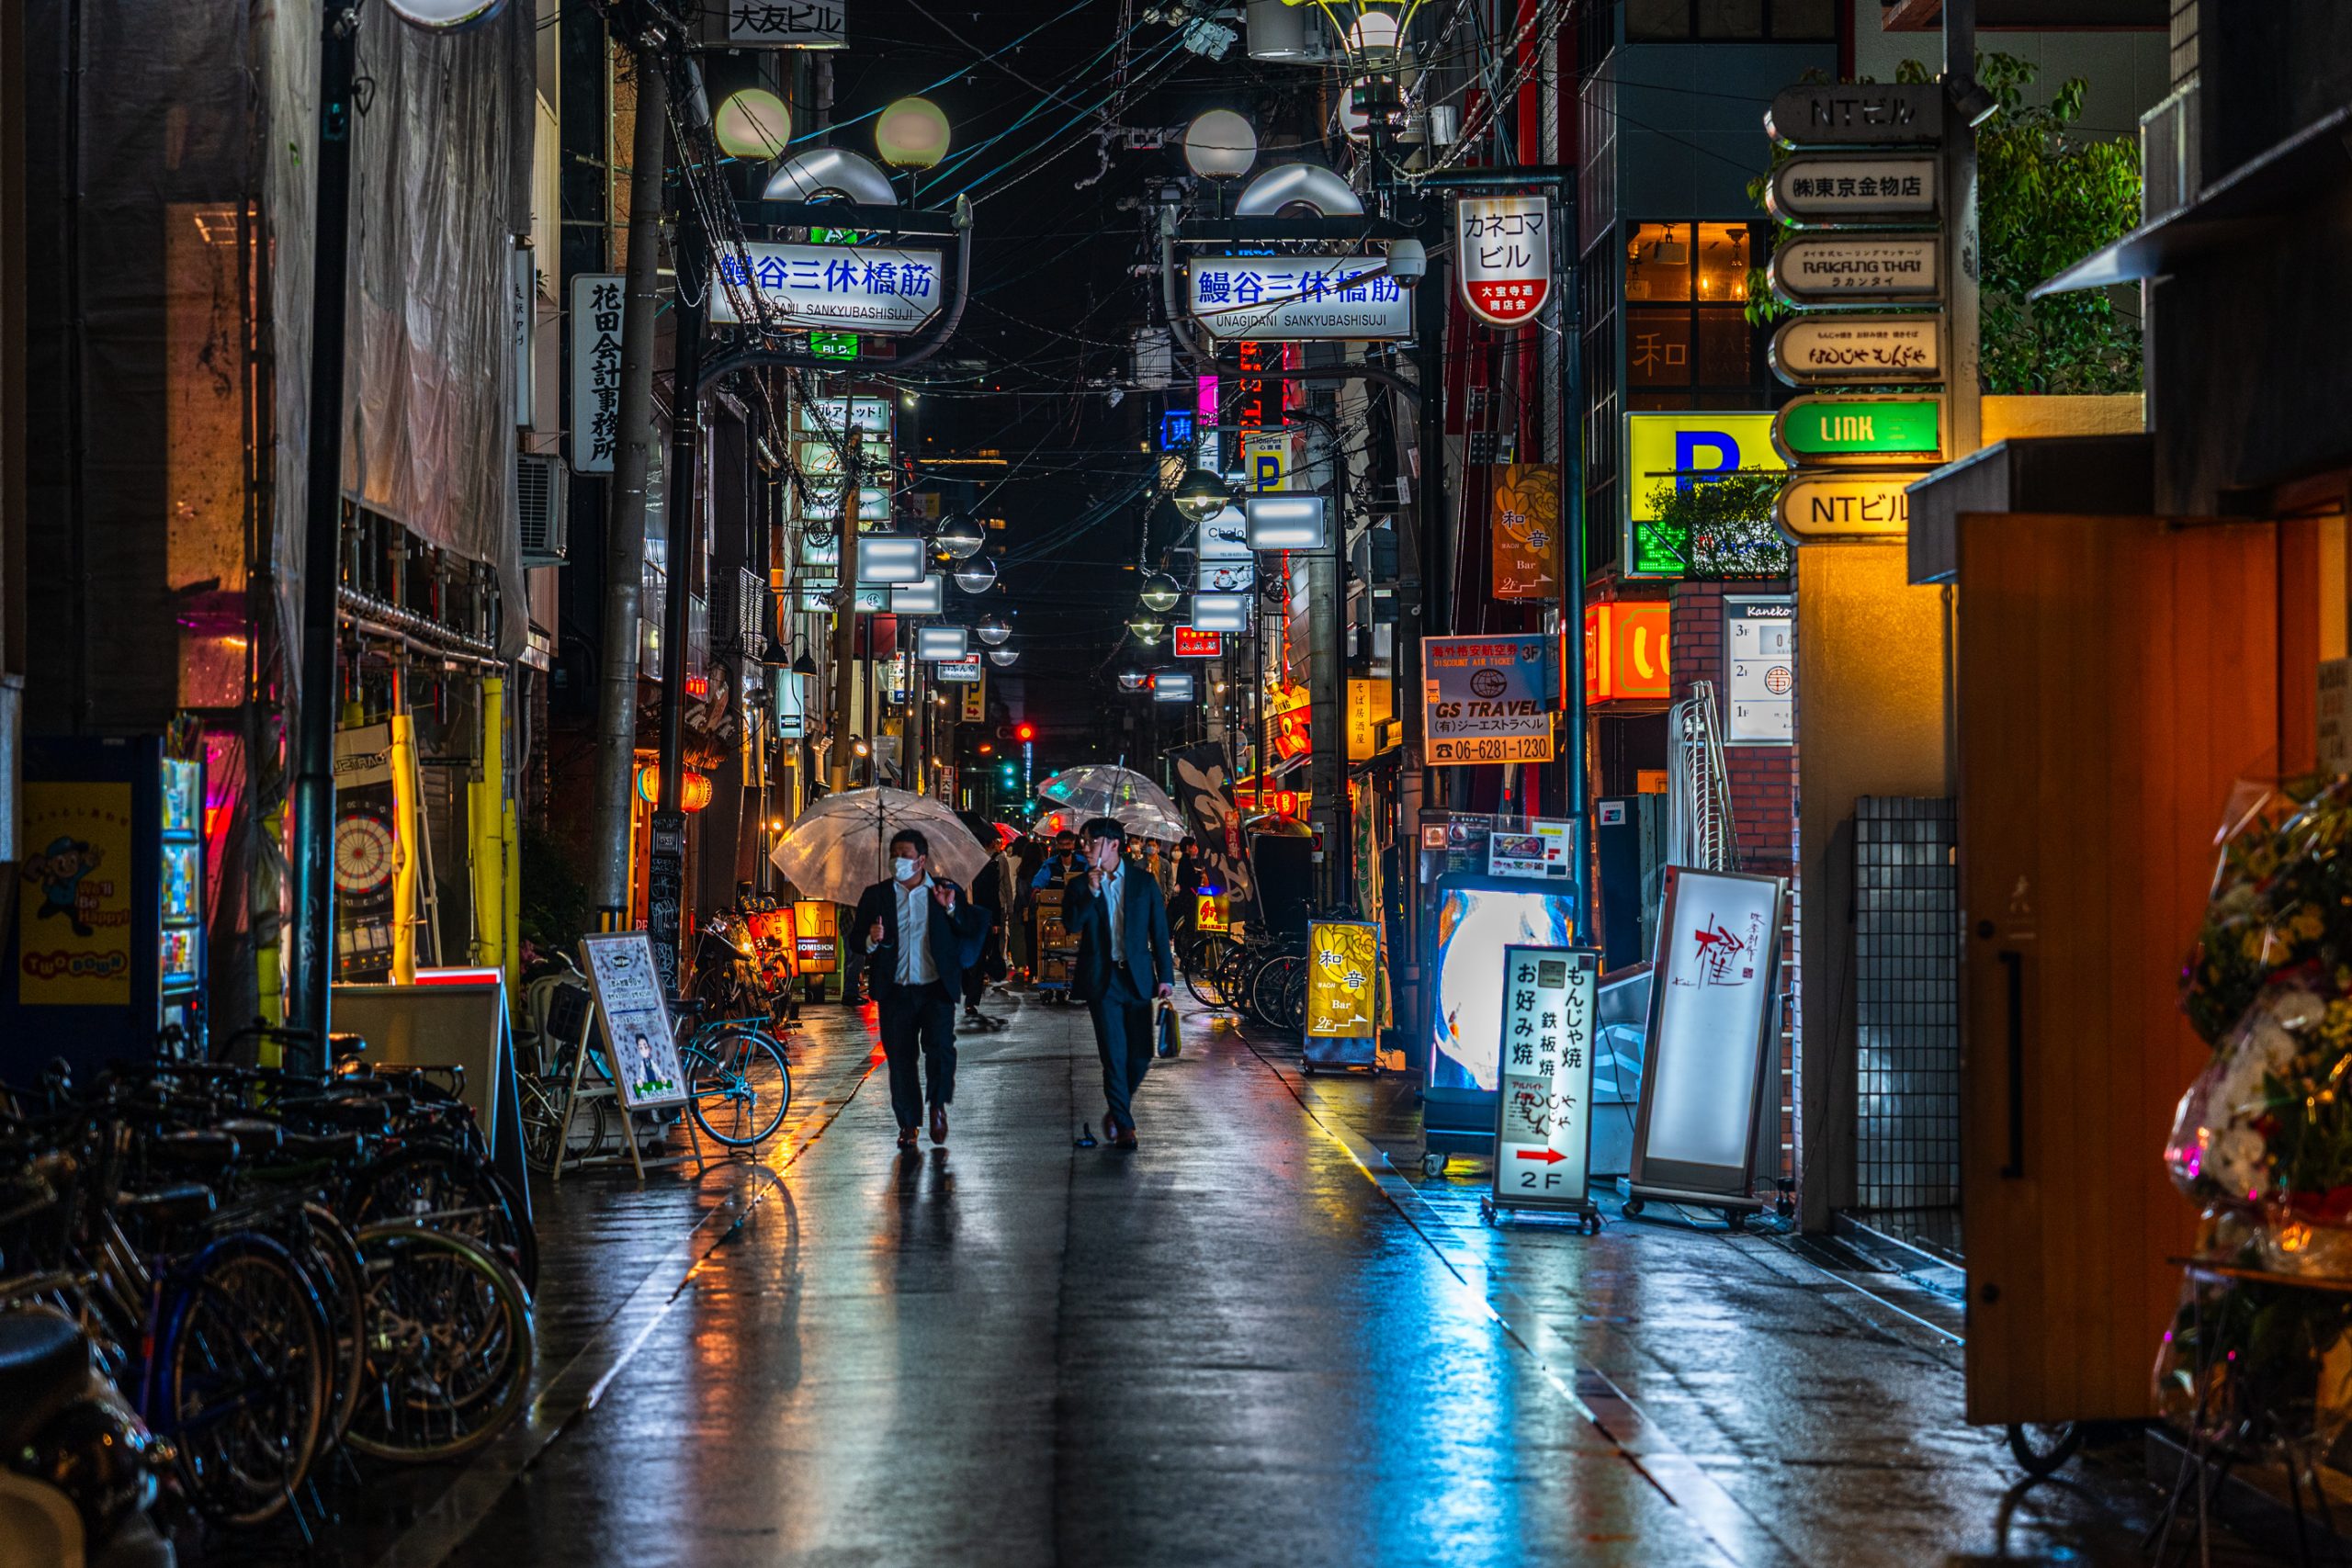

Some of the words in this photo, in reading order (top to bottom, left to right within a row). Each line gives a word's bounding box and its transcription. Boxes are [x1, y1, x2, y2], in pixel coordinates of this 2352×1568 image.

[731, 4, 842, 34] 大友ビル
[1811, 98, 1916, 127] NTビル
[1464, 212, 1544, 239] カネコマ
[1480, 244, 1532, 268] ビル
[1198, 269, 1400, 304] 鰻谷三休橋筋
[1832, 276, 1894, 288] ラカンタイ
[807, 303, 913, 321] SANKYUBASHISUJI
[1489, 299, 1526, 311] 商店会
[1216, 313, 1278, 327] UNAGIDANI
[1283, 313, 1387, 327] SANKYUBASHISUJI
[589, 282, 623, 463] 花田会計事務所
[1257, 456, 1280, 492] P
[1811, 493, 1909, 523] NTビル
[1516, 560, 1536, 570] Bar
[1500, 577, 1519, 591] 2F
[1431, 644, 1519, 657] 海外格安航空券
[1522, 646, 1540, 661] 3F
[1433, 659, 1469, 668] DISCOUNT
[1472, 658, 1487, 667] AIR
[1489, 657, 1515, 666] TICKET
[1354, 682, 1366, 745] そば居酒屋
[1435, 701, 1462, 718] GS
[1467, 700, 1543, 717] TRAVEL
[1434, 719, 1544, 733] (有)ジーエストラベル
[1455, 739, 1547, 760] 06-6281-1230
[1331, 999, 1351, 1010] Bar
[1512, 962, 1537, 1066] お好み焼
[1315, 1015, 1333, 1030] 2F
[1539, 1011, 1557, 1077] 鉄板焼
